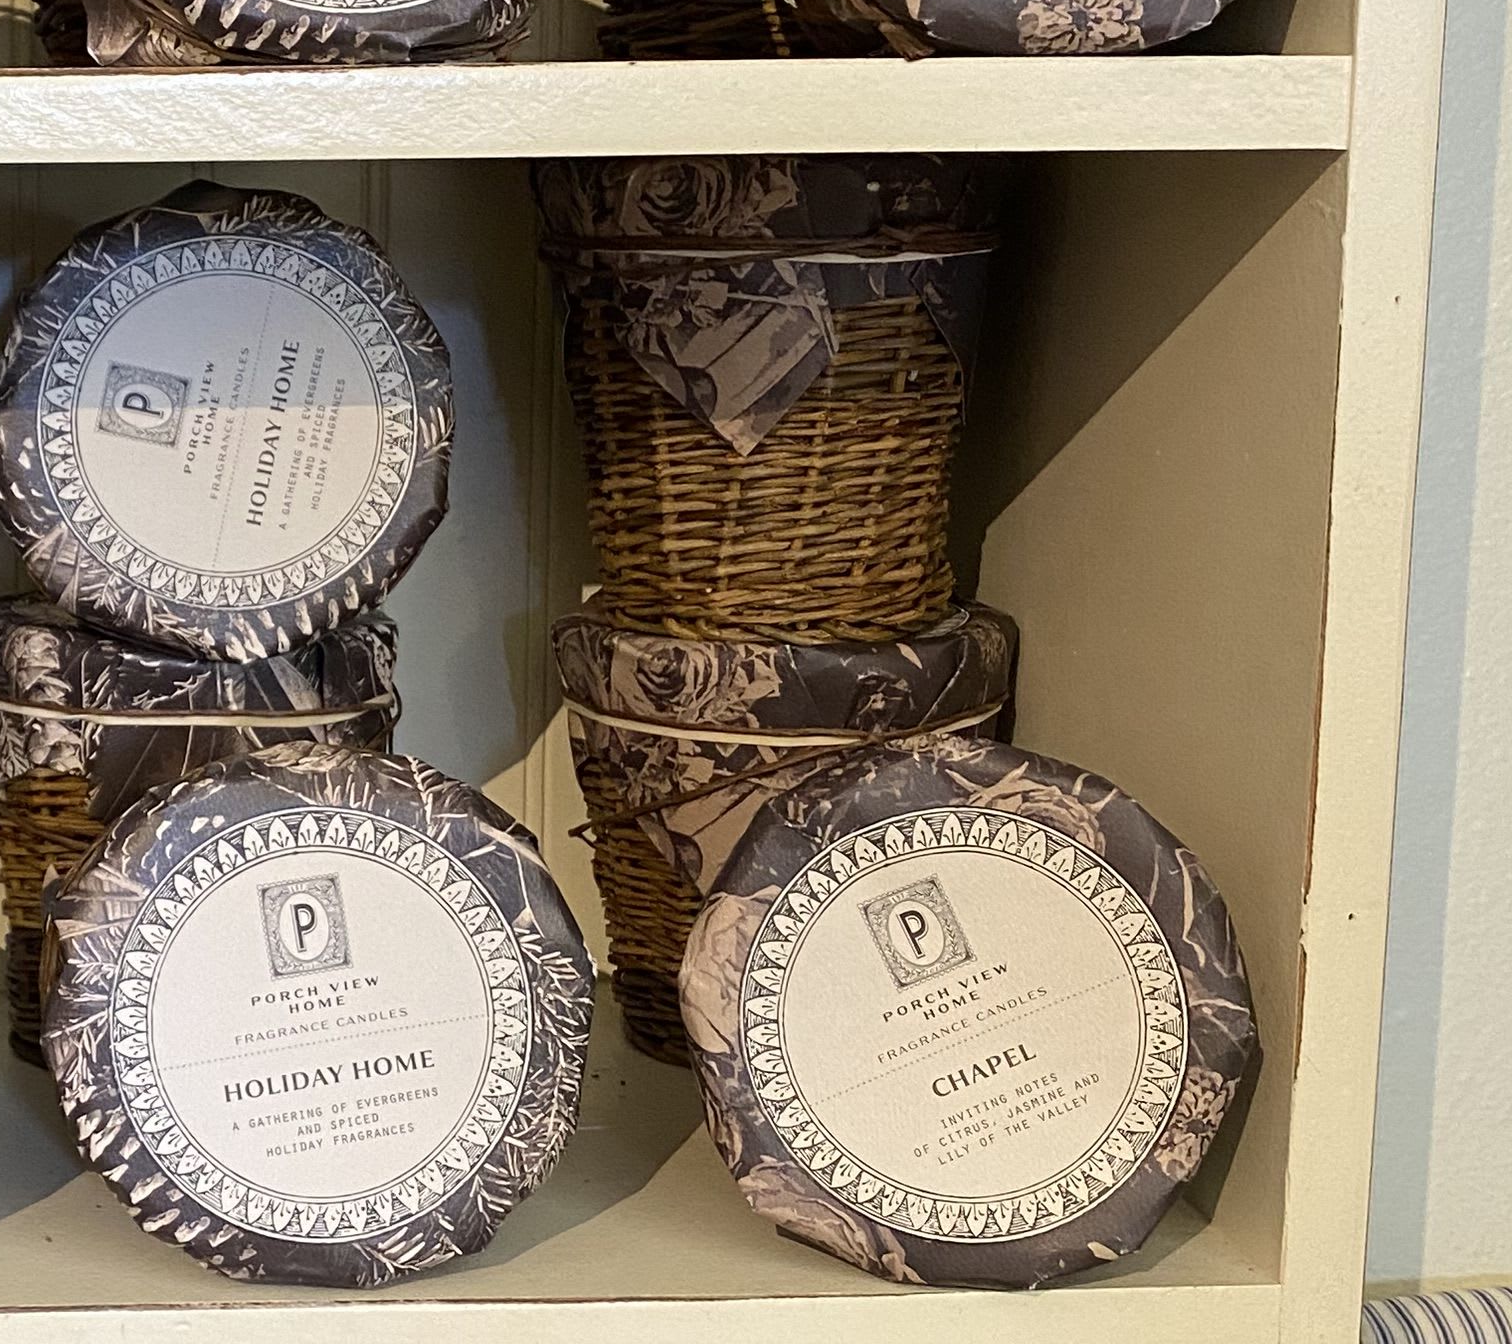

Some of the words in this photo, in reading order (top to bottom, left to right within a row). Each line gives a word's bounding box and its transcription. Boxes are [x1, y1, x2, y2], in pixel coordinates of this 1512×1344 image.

[122, 392, 165, 420] P
[183, 413, 205, 475] PORCH
[197, 360, 215, 407] VIEW
[201, 396, 221, 445] HOME
[245, 418, 283, 526] HOLIDAY
[269, 339, 300, 413] HOME
[290, 903, 318, 953] P
[896, 910, 929, 959] P
[251, 985, 319, 1007] PORCH
[329, 976, 379, 993] VIEW
[288, 995, 346, 1014] HOME
[882, 986, 950, 1023] PORCH
[958, 962, 1009, 990] VIEW
[923, 989, 981, 1020] HOME
[234, 1019, 329, 1046] FRAGRANCE
[336, 1007, 409, 1028] CANDLES
[877, 1017, 971, 1064] FRAGRANCE
[975, 986, 1048, 1022] CANDLES
[224, 1064, 343, 1103] HOLIDAY
[352, 1049, 436, 1081] HOME
[931, 1042, 1037, 1098] CHAPEL
[232, 1121, 240, 1132] A
[248, 1106, 323, 1129] GATHERING
[331, 1102, 348, 1115] OF
[356, 1086, 439, 1110] EVERGREENS
[297, 1122, 322, 1137] AND
[330, 1112, 380, 1131] SPICED
[913, 1142, 931, 1158] OF
[1006, 1086, 1066, 1119] JASMINE
[1073, 1072, 1100, 1091] AND
[940, 1093, 1008, 1130] INVITING
[1014, 1072, 1059, 1098] NOTES
[266, 1138, 323, 1158] HOLIDAY
[332, 1122, 415, 1146] FRAGRANCES
[937, 1143, 971, 1166] LILY
[978, 1132, 997, 1148] OF
[1004, 1119, 1031, 1137] THE
[1037, 1093, 1089, 1123] VALLEY
